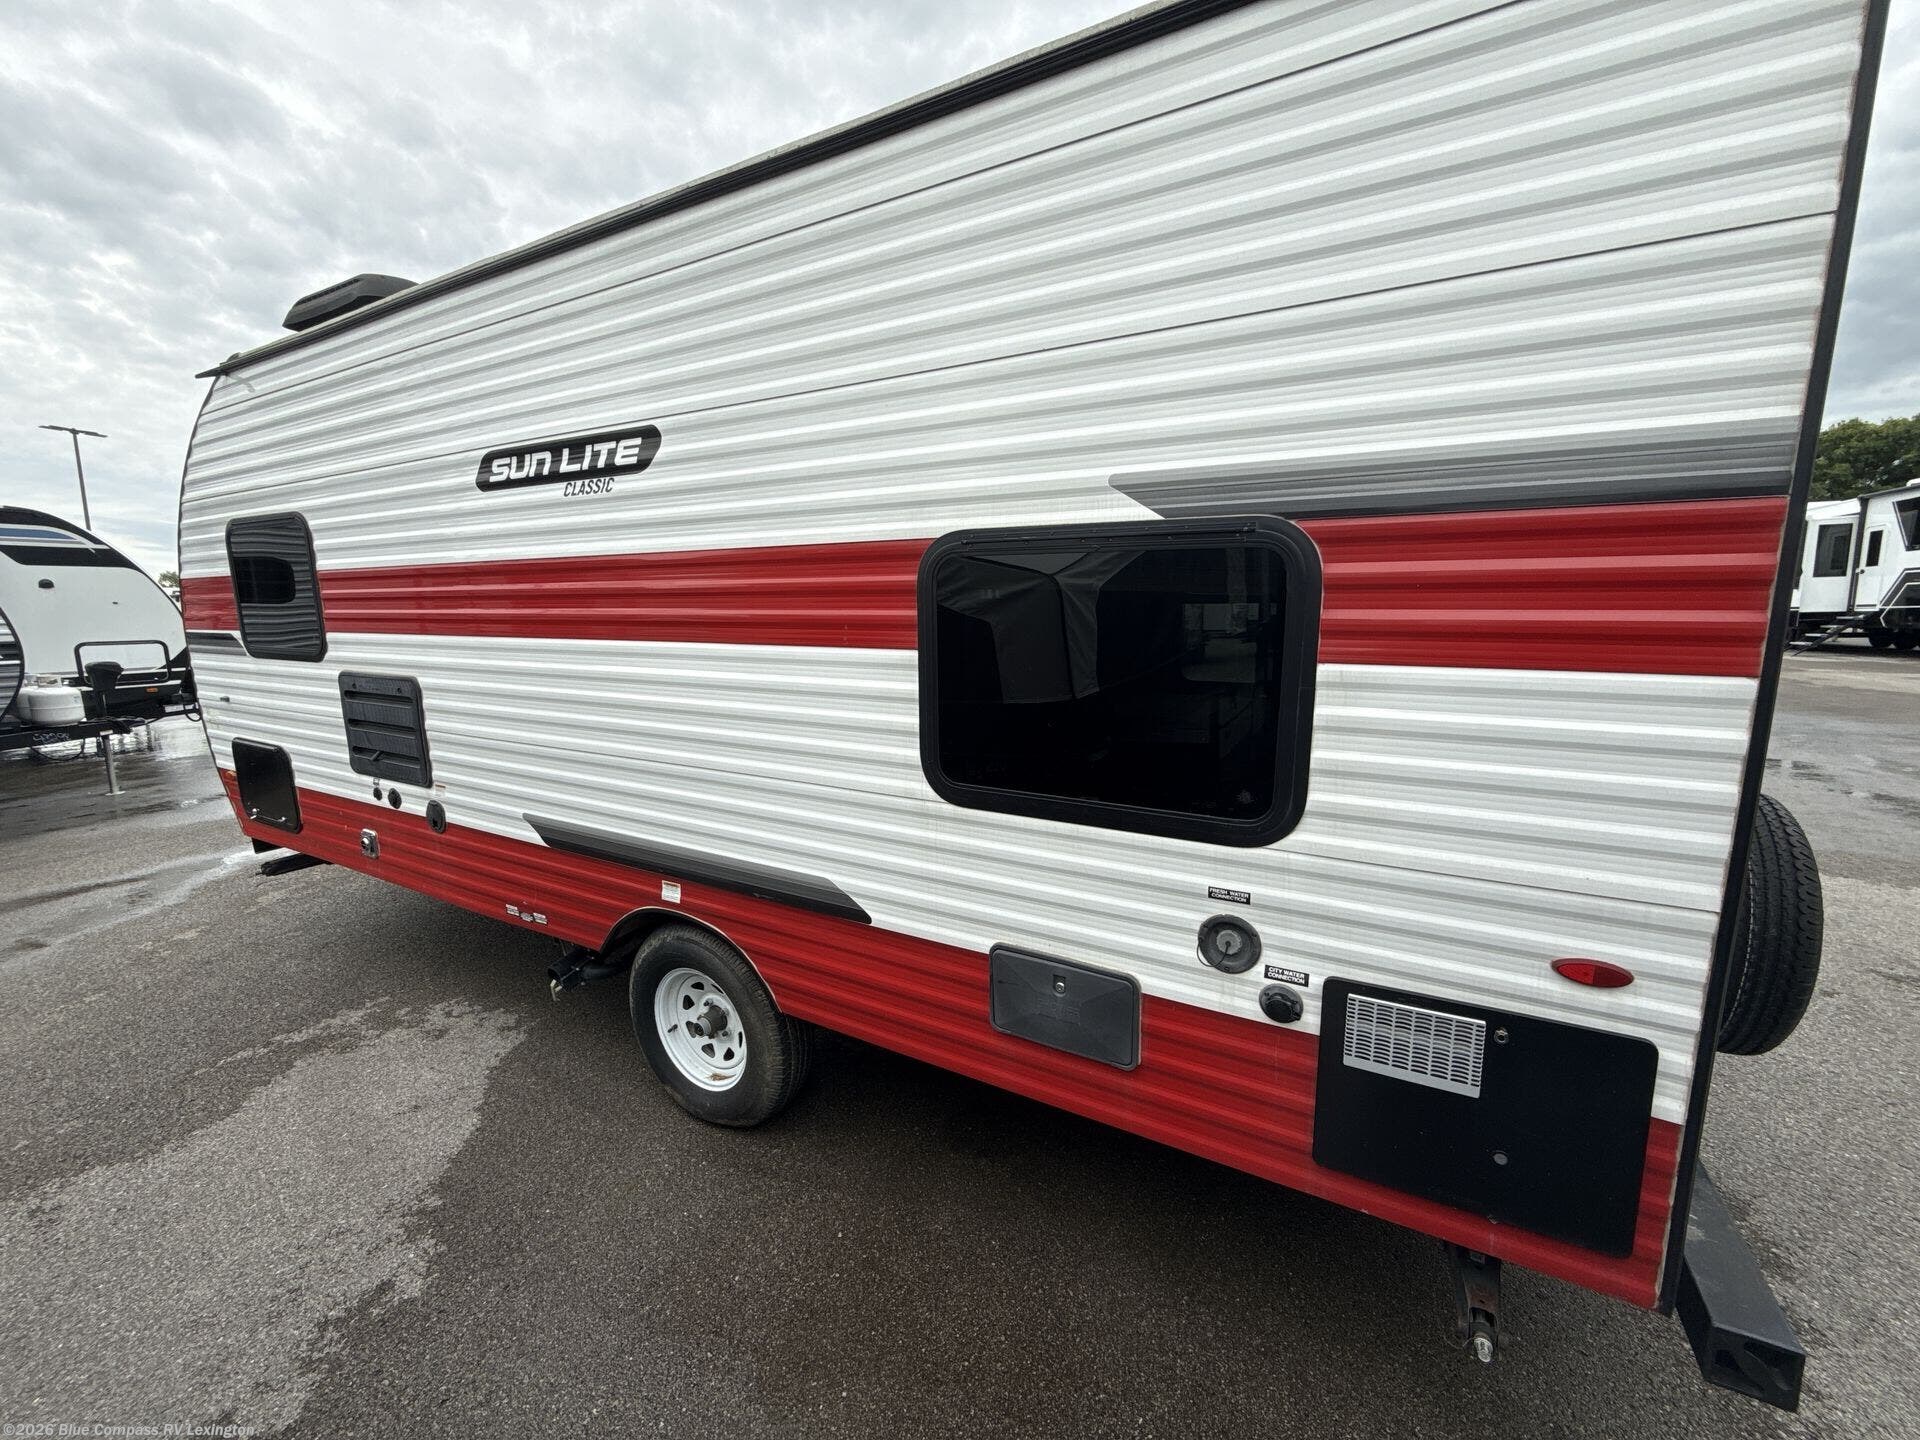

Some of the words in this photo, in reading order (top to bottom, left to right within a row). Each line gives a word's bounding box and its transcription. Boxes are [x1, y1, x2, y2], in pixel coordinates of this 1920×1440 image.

[559, 437, 642, 474] LITE
[563, 477, 615, 497] CLASSIC
[1209, 887, 1228, 896] FRESH
[1229, 890, 1249, 899] WATER
[1211, 892, 1247, 903] CONNECTION
[1267, 971, 1305, 985] CONNECTION
[1268, 966, 1282, 975] CITY
[1283, 969, 1305, 979] WATER
